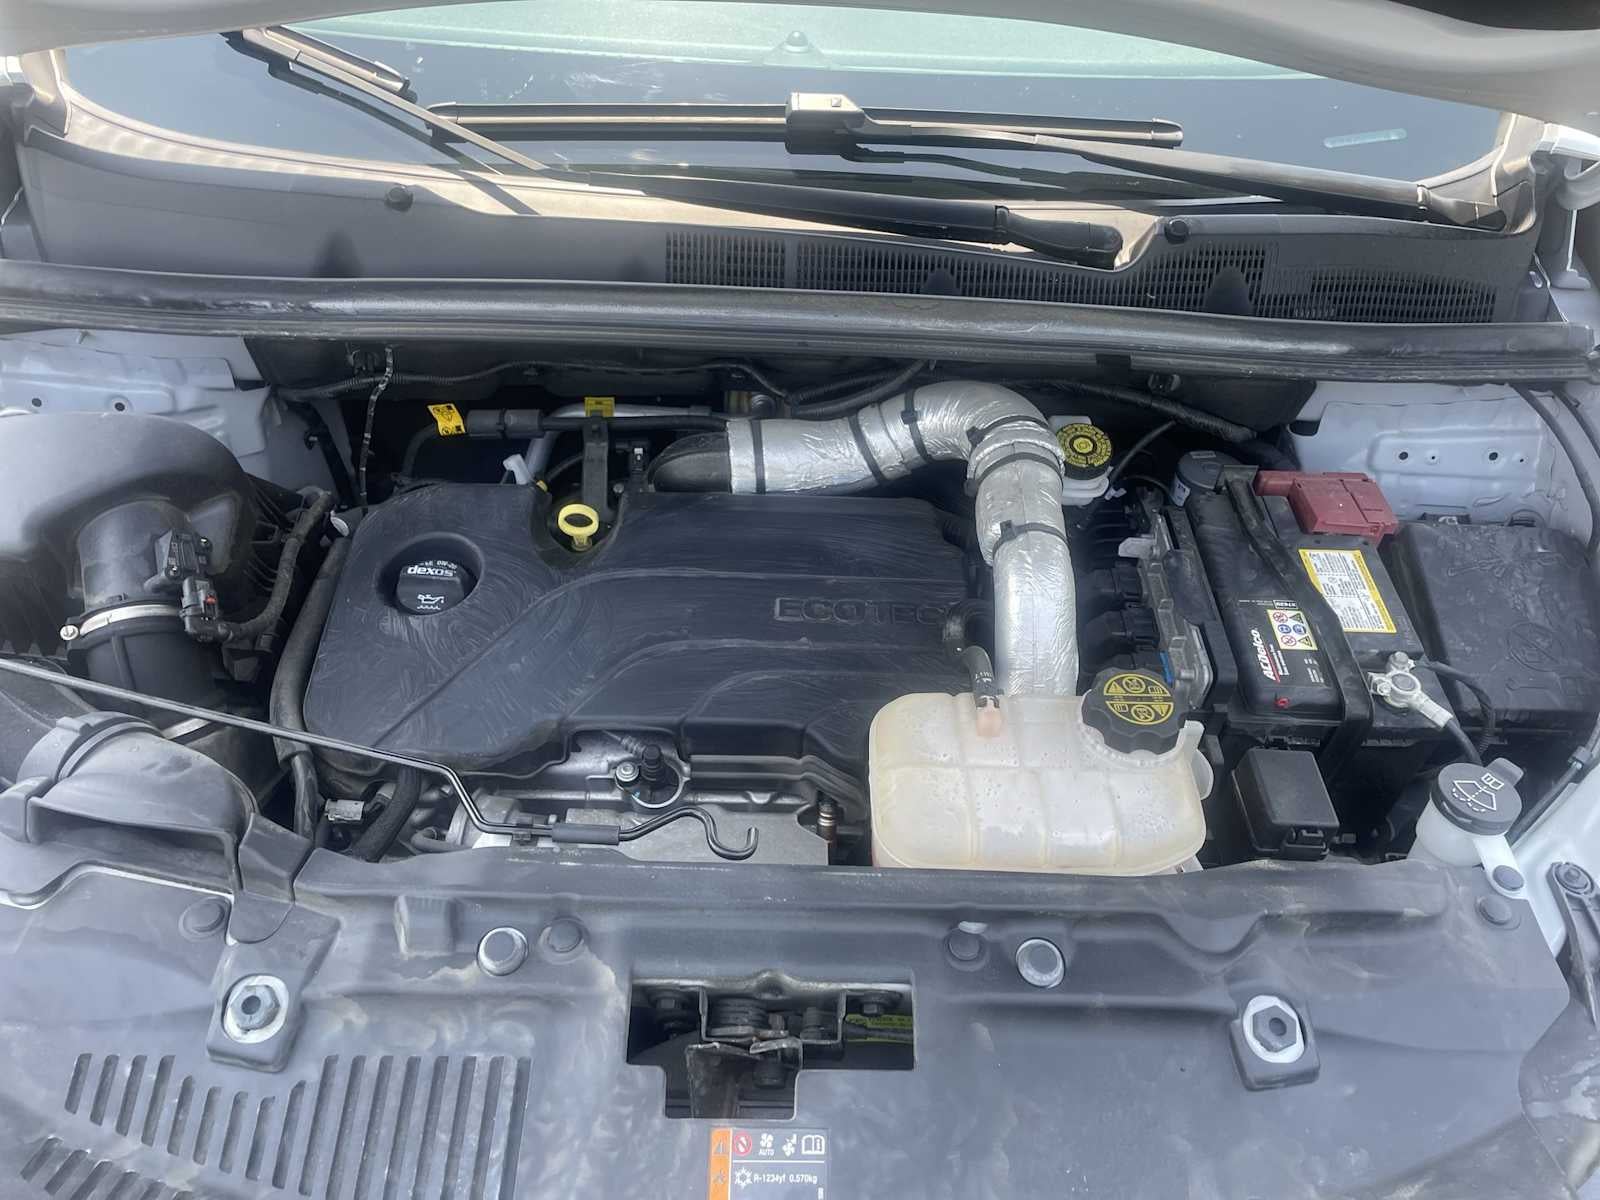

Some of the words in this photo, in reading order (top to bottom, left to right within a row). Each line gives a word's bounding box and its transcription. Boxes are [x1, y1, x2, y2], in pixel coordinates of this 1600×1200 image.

[407, 565, 454, 577] dexos
[774, 597, 946, 625] ECOTEC
[1251, 629, 1277, 681] ACDelco
[758, 1148, 775, 1156] AUTO
[788, 1174, 818, 1185] 0.570kg
